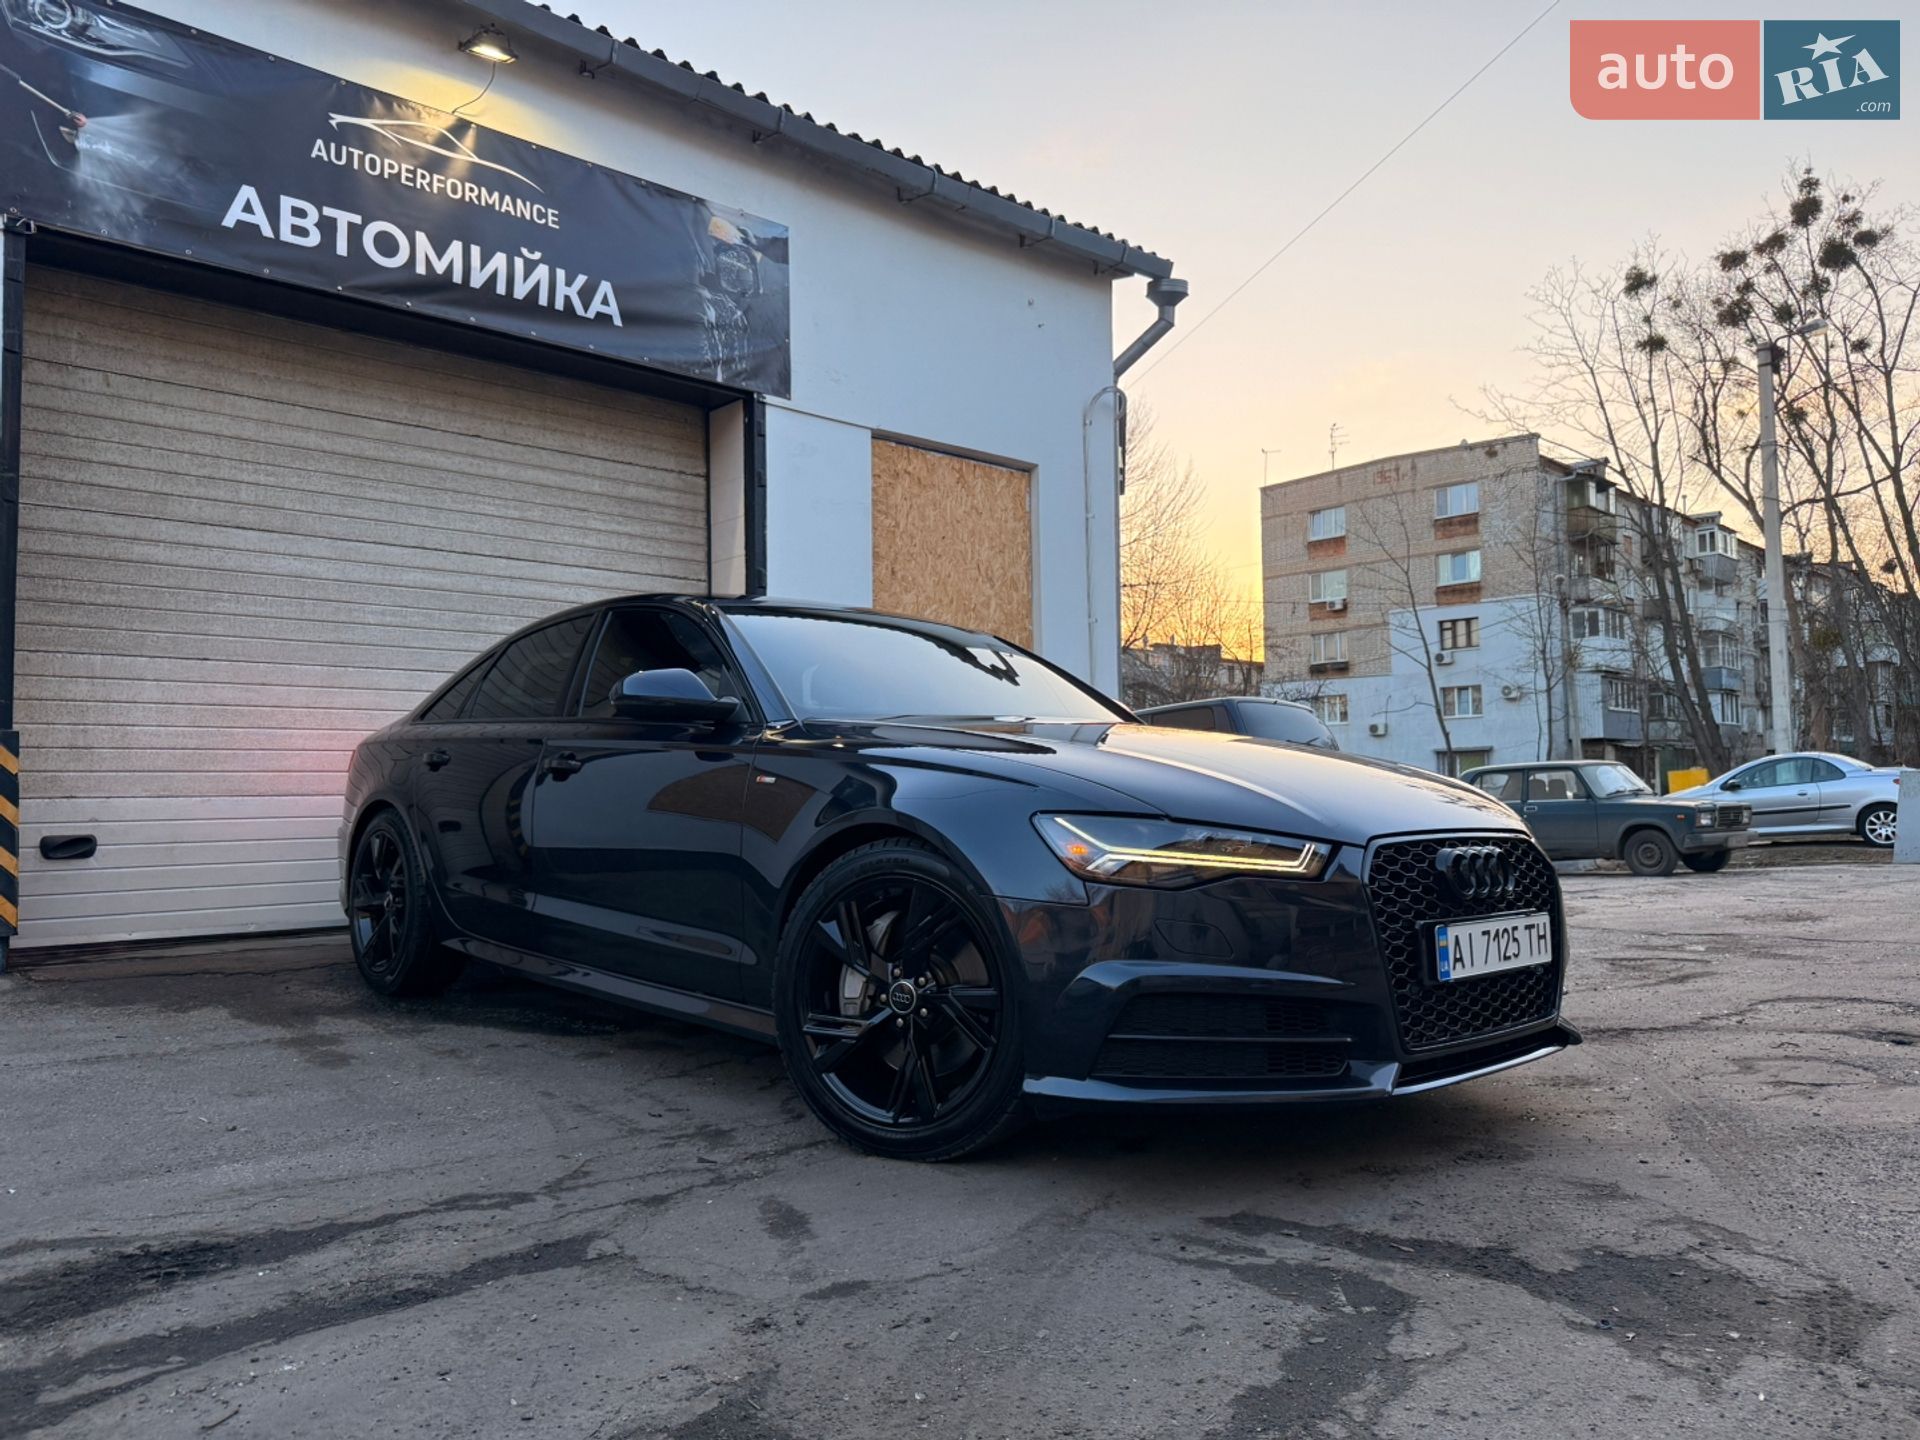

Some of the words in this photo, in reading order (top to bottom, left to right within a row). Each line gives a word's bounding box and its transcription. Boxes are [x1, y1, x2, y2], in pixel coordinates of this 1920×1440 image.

[310, 137, 560, 230] AUTOPERFORMANCE
[220, 184, 624, 328] АВТОМИЙКА
[1481, 925, 1521, 965] 7125
[1524, 922, 1548, 958] TH
